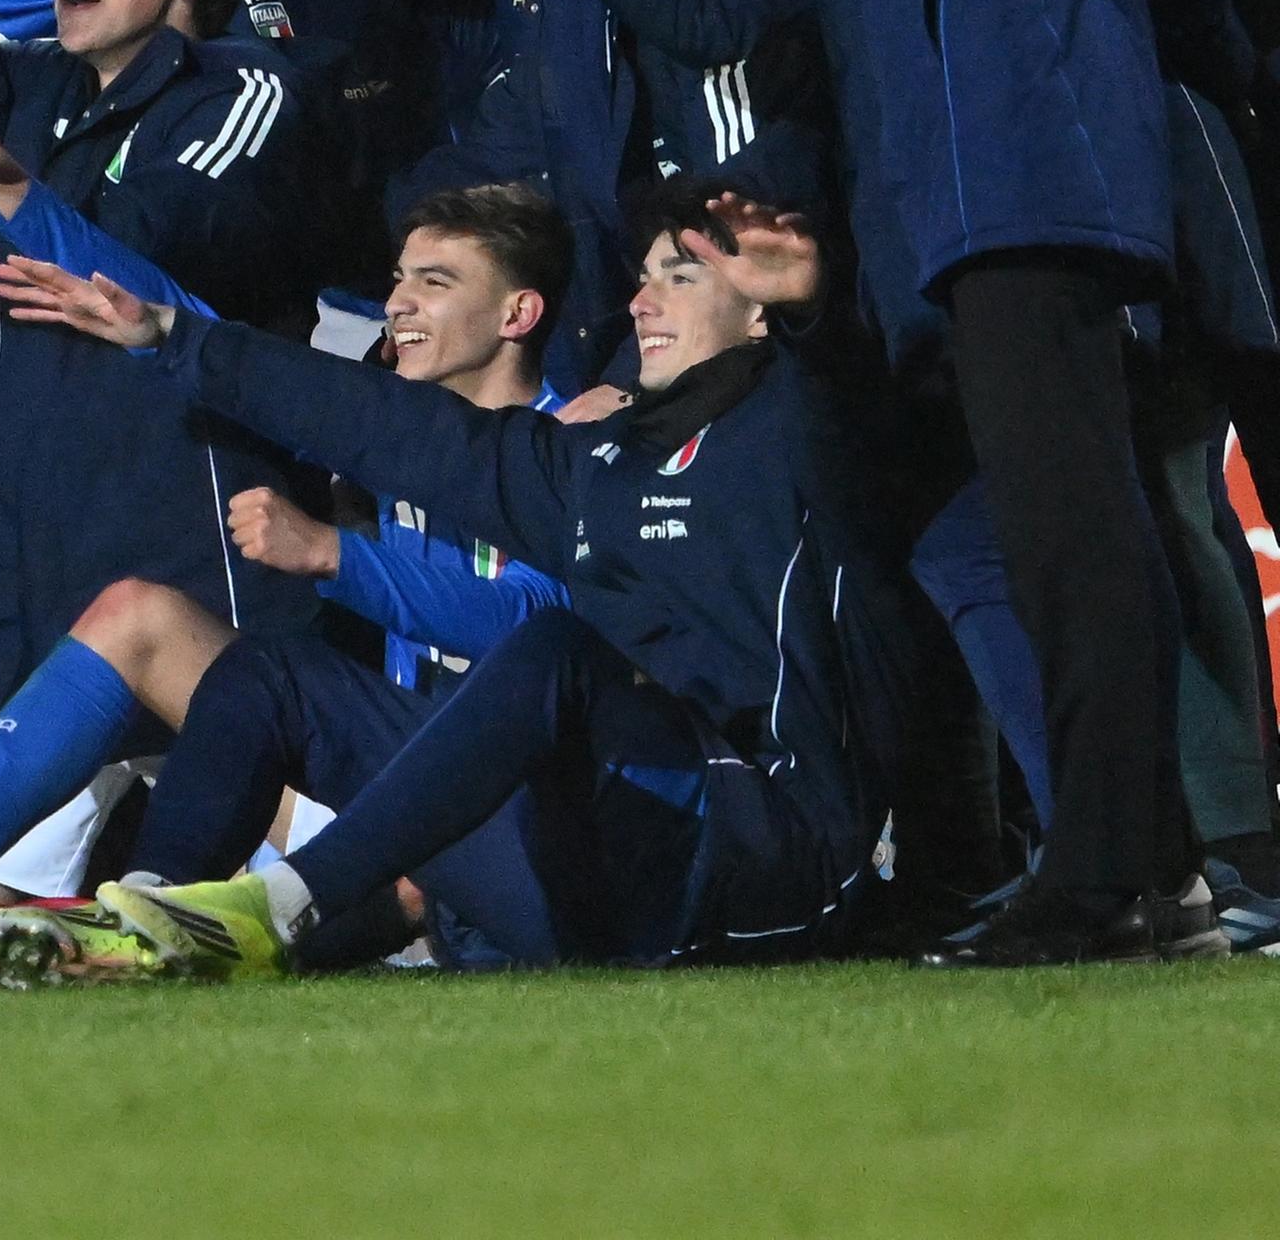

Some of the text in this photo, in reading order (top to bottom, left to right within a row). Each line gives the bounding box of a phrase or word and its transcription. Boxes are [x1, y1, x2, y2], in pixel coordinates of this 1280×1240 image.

[254, 8, 285, 24] ITALIA
[344, 86, 369, 100] eni
[640, 520, 666, 539] eni
